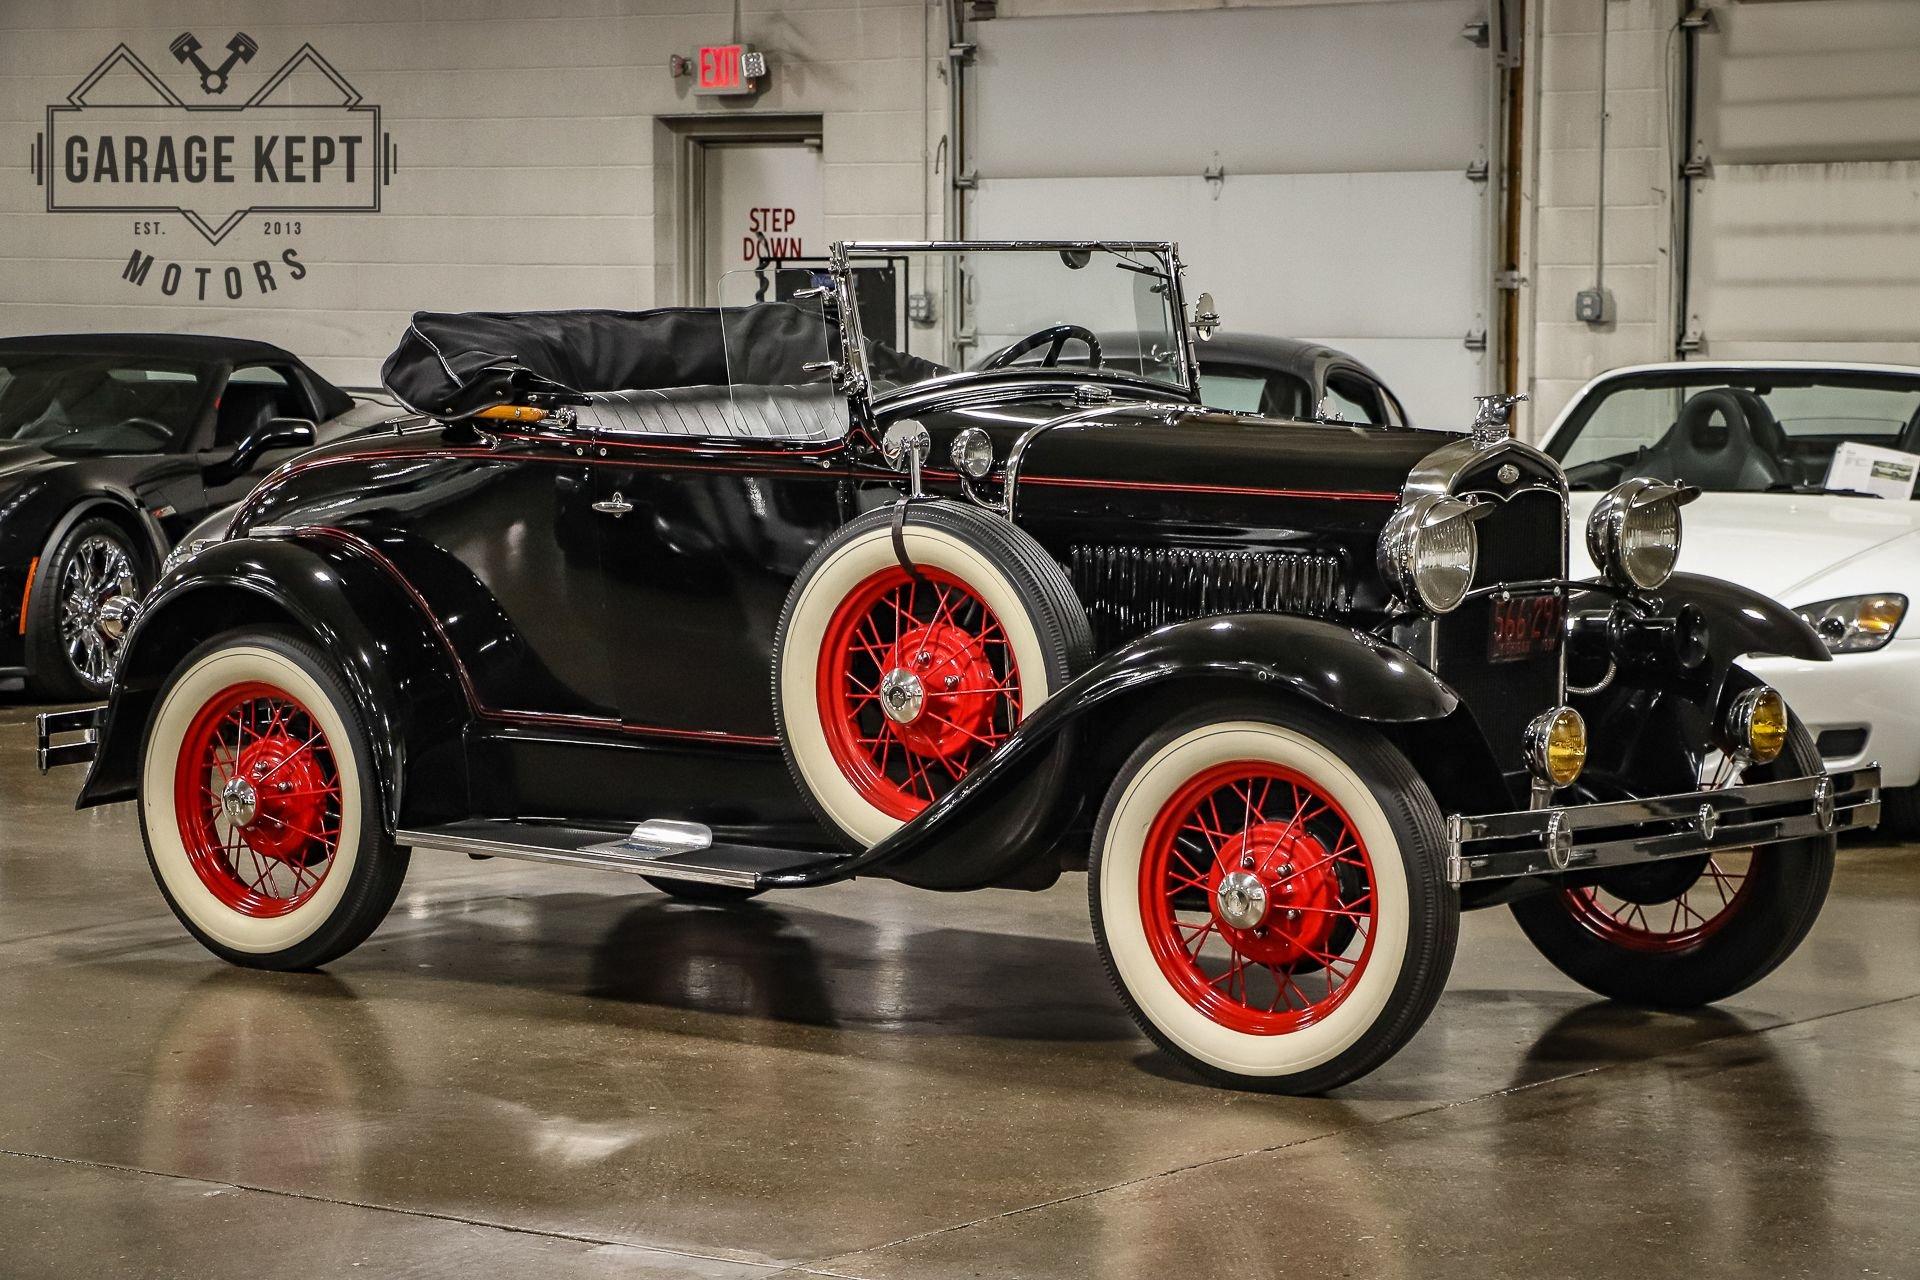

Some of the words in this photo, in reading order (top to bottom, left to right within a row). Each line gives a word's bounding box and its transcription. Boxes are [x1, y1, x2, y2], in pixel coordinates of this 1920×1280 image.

[700, 46, 741, 88] EXIT
[749, 207, 796, 233] STEP
[743, 237, 802, 261] DOWN
